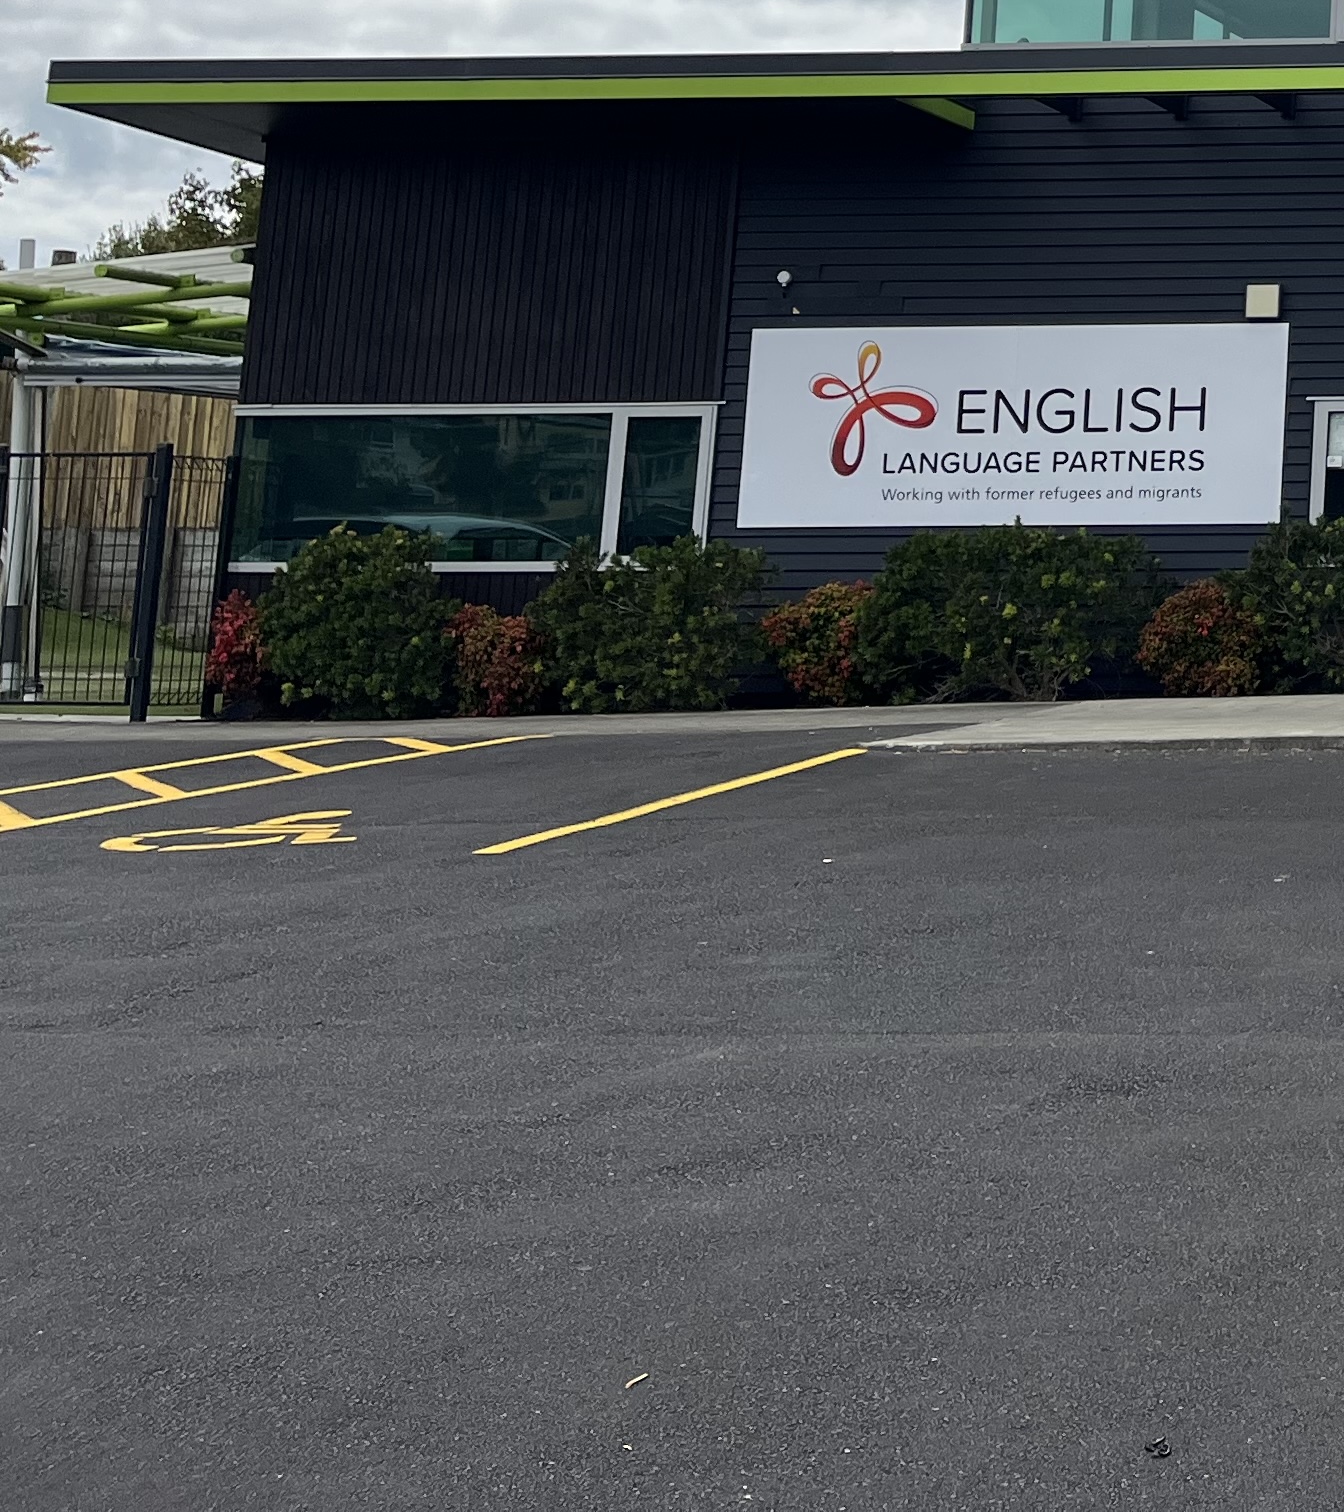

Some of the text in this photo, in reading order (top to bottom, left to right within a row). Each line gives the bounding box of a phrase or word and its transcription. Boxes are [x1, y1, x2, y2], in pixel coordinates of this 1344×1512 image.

[956, 387, 1207, 434] ENGLISH
[882, 449, 1205, 474] LANGUAGE PARTNERS
[881, 486, 1203, 505] Working with former refugees and migrants
